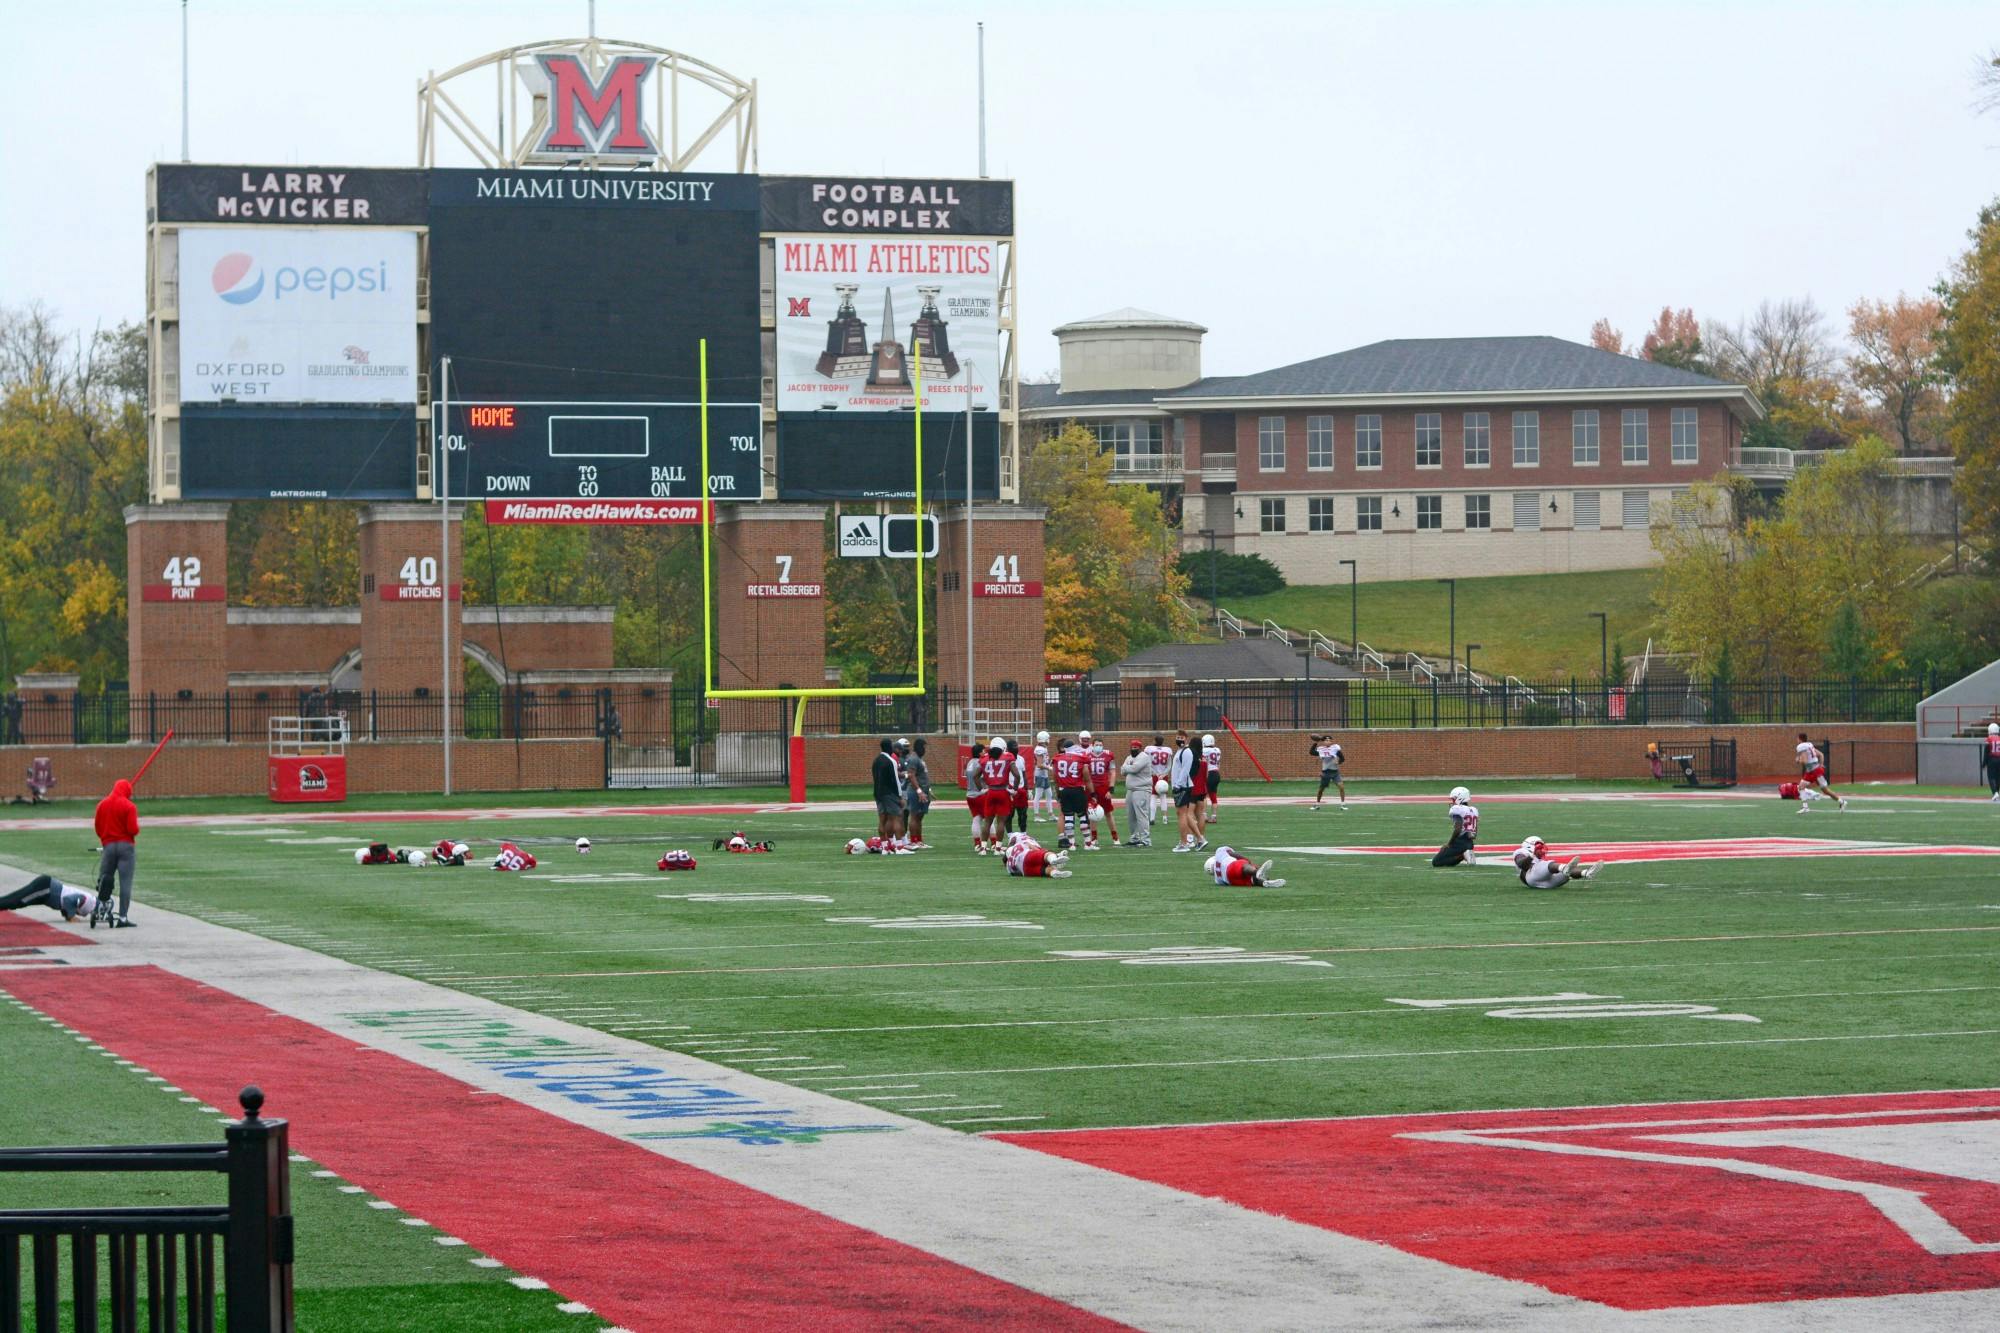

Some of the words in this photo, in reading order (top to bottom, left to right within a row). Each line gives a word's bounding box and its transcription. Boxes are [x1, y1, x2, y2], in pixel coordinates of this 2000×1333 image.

[537, 53, 657, 153] M
[241, 172, 347, 194] LARRY
[477, 178, 564, 199] MIAMI
[570, 179, 715, 202] UNIVERSITY
[812, 183, 961, 206] FOOTBALL
[217, 197, 371, 220] McVICKER
[822, 207, 951, 229] COMPLEX
[784, 243, 857, 272] MIAMI
[866, 244, 990, 274] ATHLETICS
[275, 261, 387, 300] pepsi
[787, 297, 811, 317] M
[947, 297, 991, 308] GRADUATING
[949, 307, 990, 318] CHAMPIONS
[196, 362, 286, 377] OXFORD
[307, 365, 360, 378] GRADUATING
[361, 365, 409, 378] CHAMPIONS
[211, 382, 271, 395] WEST
[786, 383, 817, 393] JACOBY
[819, 383, 850, 393] TROPHY
[928, 385, 952, 394] REESE
[954, 385, 984, 394] TROHY
[848, 397, 900, 407] CARTWRIGHT
[471, 407, 515, 427] HOME
[730, 435, 757, 451] TOL
[578, 466, 597, 481] TO
[651, 466, 685, 482] BALL
[486, 475, 531, 491] DOWN
[578, 481, 599, 497] GO
[651, 482, 670, 497] ON
[708, 475, 736, 493] QTR
[503, 503, 698, 520] MiamiRedHawks.com
[842, 536, 878, 547] adidas
[162, 556, 202, 587] 42
[399, 556, 437, 586] 40
[775, 556, 792, 583] 7
[989, 555, 1020, 582] 41
[171, 587, 195, 600] PONT
[398, 586, 442, 599] HITCHENS
[747, 584, 821, 597] ROETHLISBERGER
[984, 583, 1025, 596] PRENTICE
[1150, 751, 1168, 766] 38
[984, 759, 1006, 778] 47
[1057, 759, 1079, 778] 94
[1090, 761, 1105, 775] 16
[302, 779, 325, 787] MIAMI
